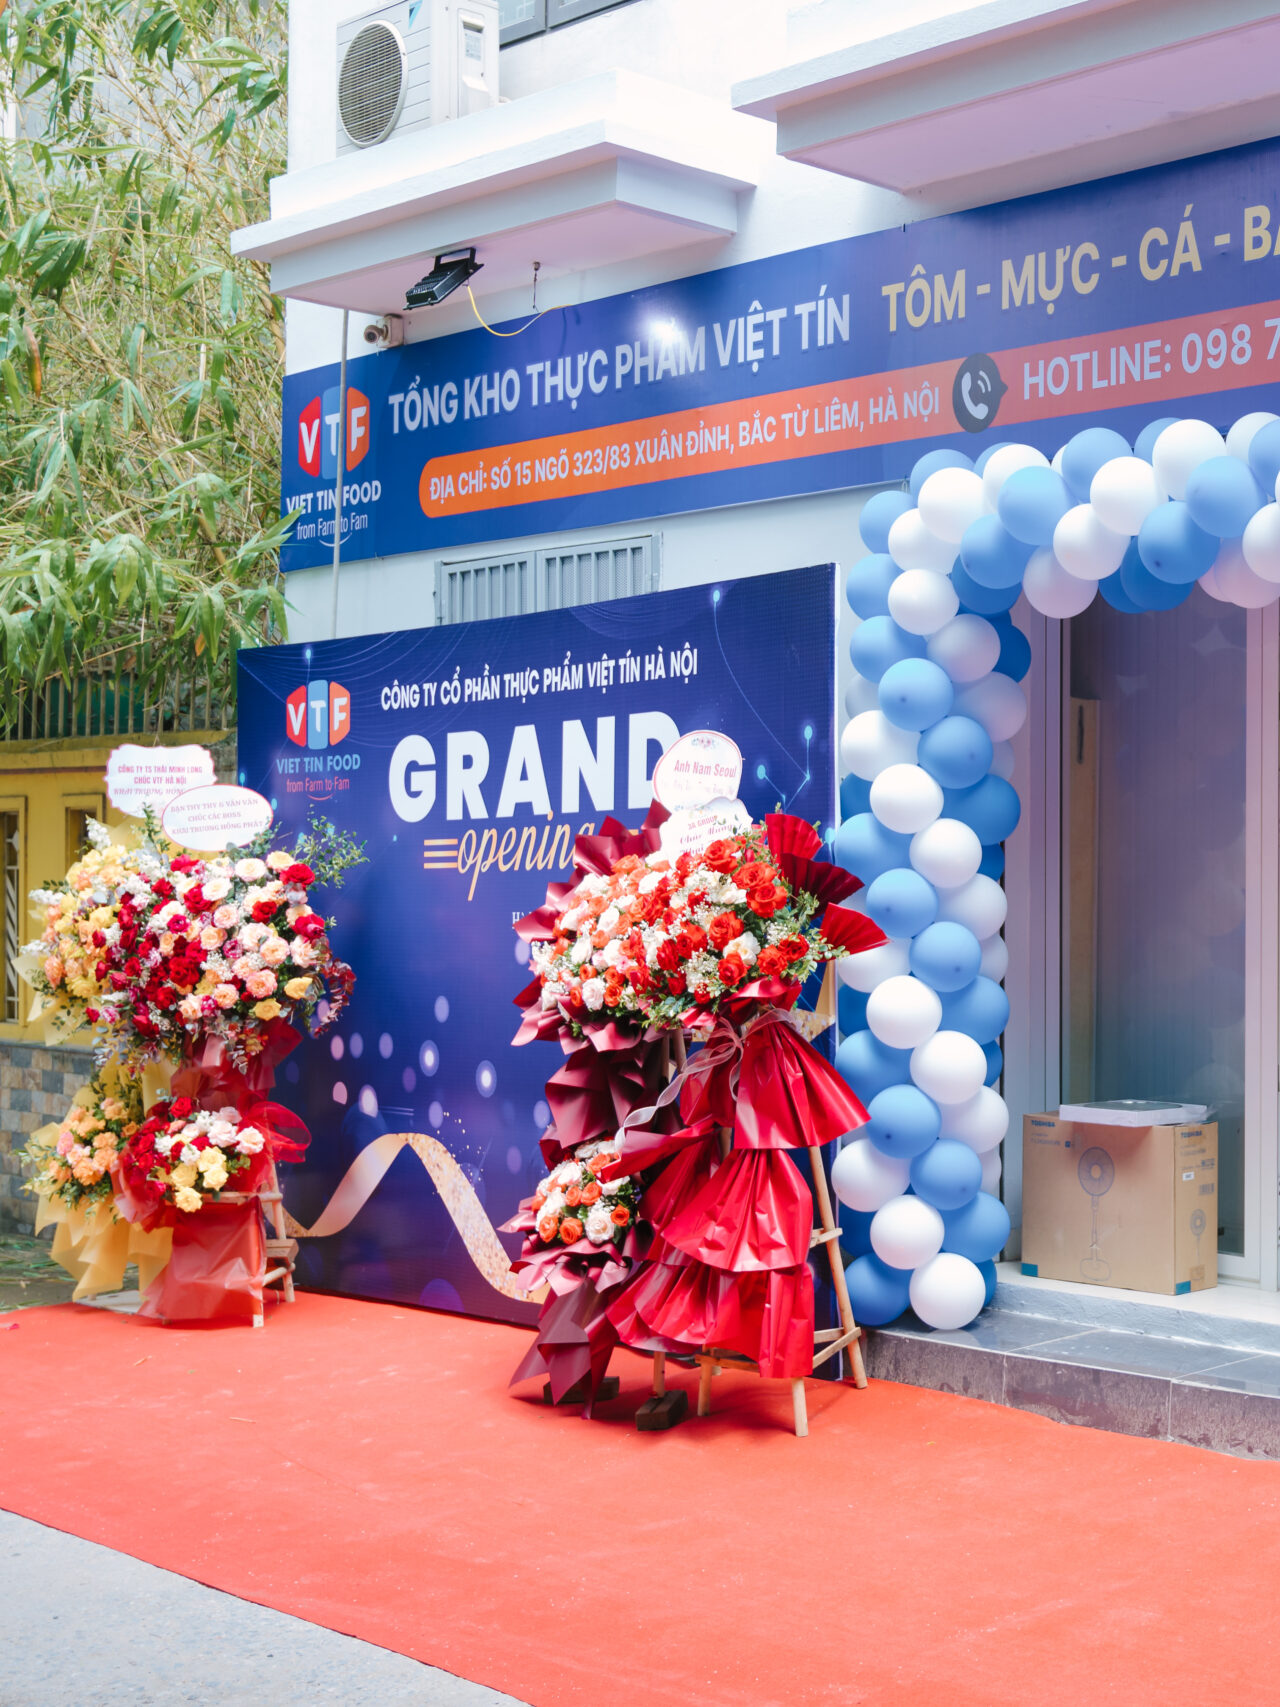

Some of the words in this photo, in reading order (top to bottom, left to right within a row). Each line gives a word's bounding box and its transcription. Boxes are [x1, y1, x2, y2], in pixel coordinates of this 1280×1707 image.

[882, 264, 966, 332] TÔM
[977, 284, 990, 295] -
[1001, 242, 1100, 315] MỰC
[1112, 255, 1127, 268] -
[1139, 204, 1202, 281] CÁ
[1214, 233, 1231, 246] -
[388, 375, 459, 434] TỔNG
[464, 369, 520, 420] KHO
[526, 349, 608, 410] THỰC
[714, 300, 787, 373] VIỆT
[795, 285, 850, 351] TÍN
[1024, 339, 1172, 400] HOTLINE:
[1181, 323, 1252, 374] 098
[300, 406, 367, 464] VTF
[429, 475, 455, 504] ĐỊA
[458, 462, 487, 495] CHỈ:
[490, 457, 512, 489] SỐ
[514, 462, 531, 486] 15
[535, 448, 570, 483] NGÕ
[573, 444, 631, 476] 323/83
[634, 429, 683, 466] XUÂN
[686, 420, 734, 456] ĐỈNH,
[738, 410, 777, 447] BẮC
[781, 404, 809, 437] TỪ
[814, 397, 865, 434] LIÊM,
[869, 387, 898, 425] HÀ
[904, 381, 940, 423] NỘI
[286, 493, 314, 515] VIET
[316, 488, 338, 512] TIN
[343, 480, 382, 506] FOOD
[297, 521, 316, 540] from
[351, 512, 368, 531] Fam
[381, 679, 420, 711] CÔNG
[423, 682, 438, 706] TY
[440, 666, 461, 705] CỔ
[464, 664, 500, 702] PHẦN
[503, 667, 540, 703] THỰC
[543, 651, 583, 693] PHẨM
[587, 653, 615, 693] VIỆT
[618, 649, 640, 684] TÍN
[644, 645, 666, 681] HÀ
[670, 642, 698, 684] NỘI
[287, 696, 348, 736] VTF
[276, 758, 301, 774] VIET
[304, 756, 324, 772] TIN
[327, 754, 361, 772] FOOD
[287, 778, 304, 792] from
[305, 777, 324, 792] Farm
[325, 778, 333, 790] to
[334, 776, 350, 790] Fam
[388, 711, 682, 823] GRAND
[674, 760, 690, 773] Anh
[692, 761, 711, 776] Nam
[457, 810, 595, 901] openin
